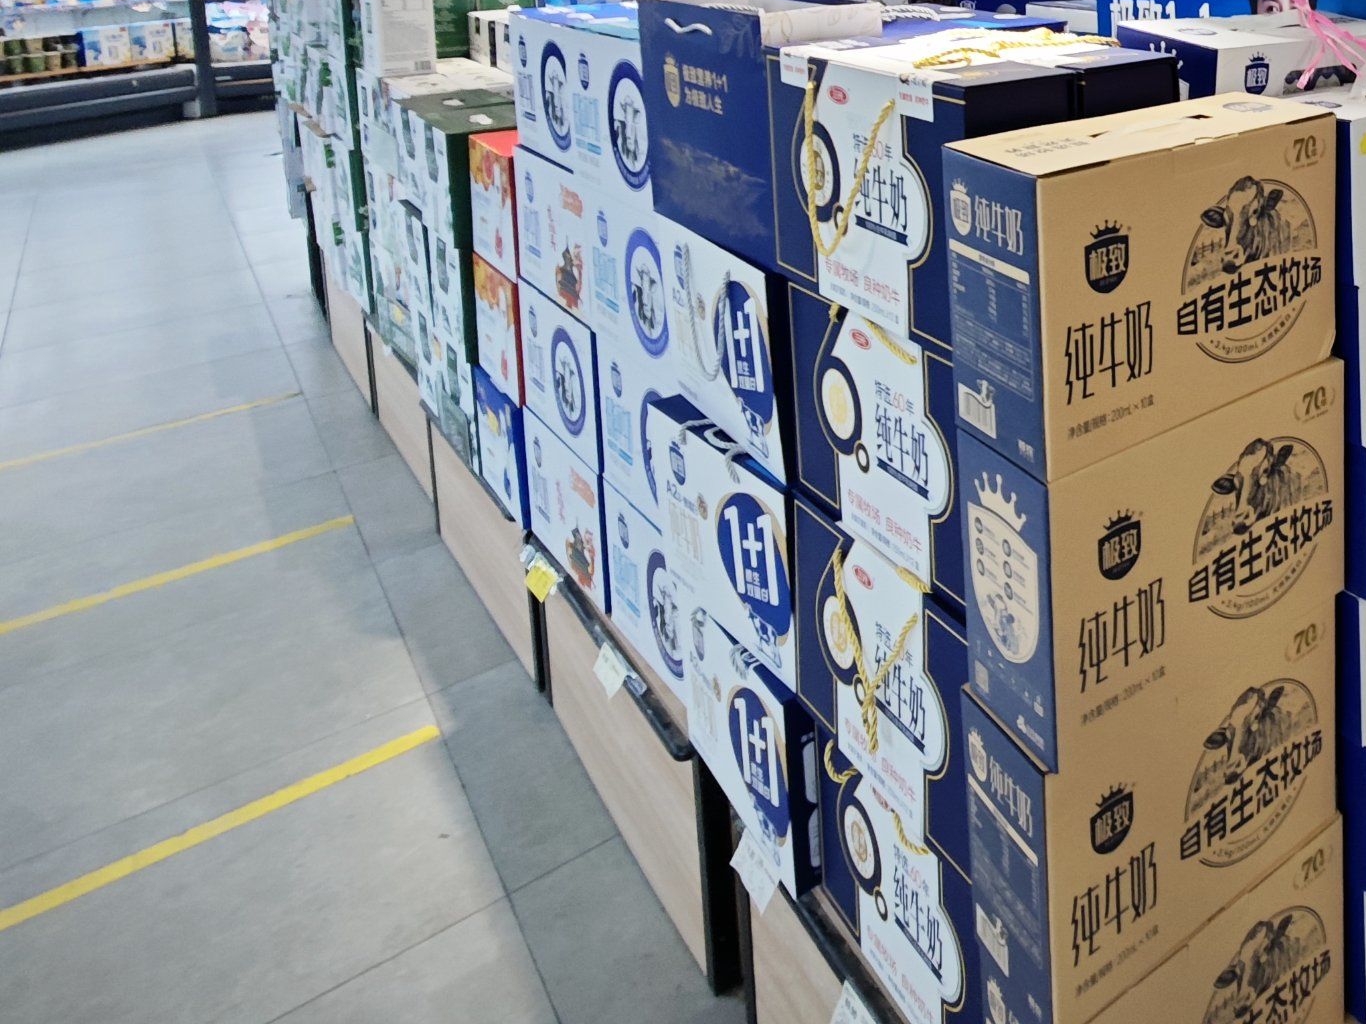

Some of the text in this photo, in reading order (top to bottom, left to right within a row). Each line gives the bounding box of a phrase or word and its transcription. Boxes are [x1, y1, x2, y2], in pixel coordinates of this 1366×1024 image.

[854, 157, 909, 232] 纯牛奶
[974, 194, 1024, 257] 纯牛奶
[1089, 241, 1127, 281] 极致
[1176, 255, 1322, 336] 自有生态牧场
[1064, 300, 1154, 406] 纯牛奶
[874, 402, 930, 488] 纯牛奶
[724, 505, 780, 606] 1+1
[1101, 527, 1139, 571] 极致
[1187, 498, 1334, 603] 自有生态牧场
[1077, 576, 1165, 694] 纯牛奶
[733, 697, 780, 808] 1+1
[989, 754, 1035, 839] 纯牛奶
[1179, 729, 1323, 861] 自有生态牧场
[1093, 800, 1131, 842] 极致
[892, 865, 944, 971] 纯牛奶
[1070, 841, 1158, 968] 纯牛奶
